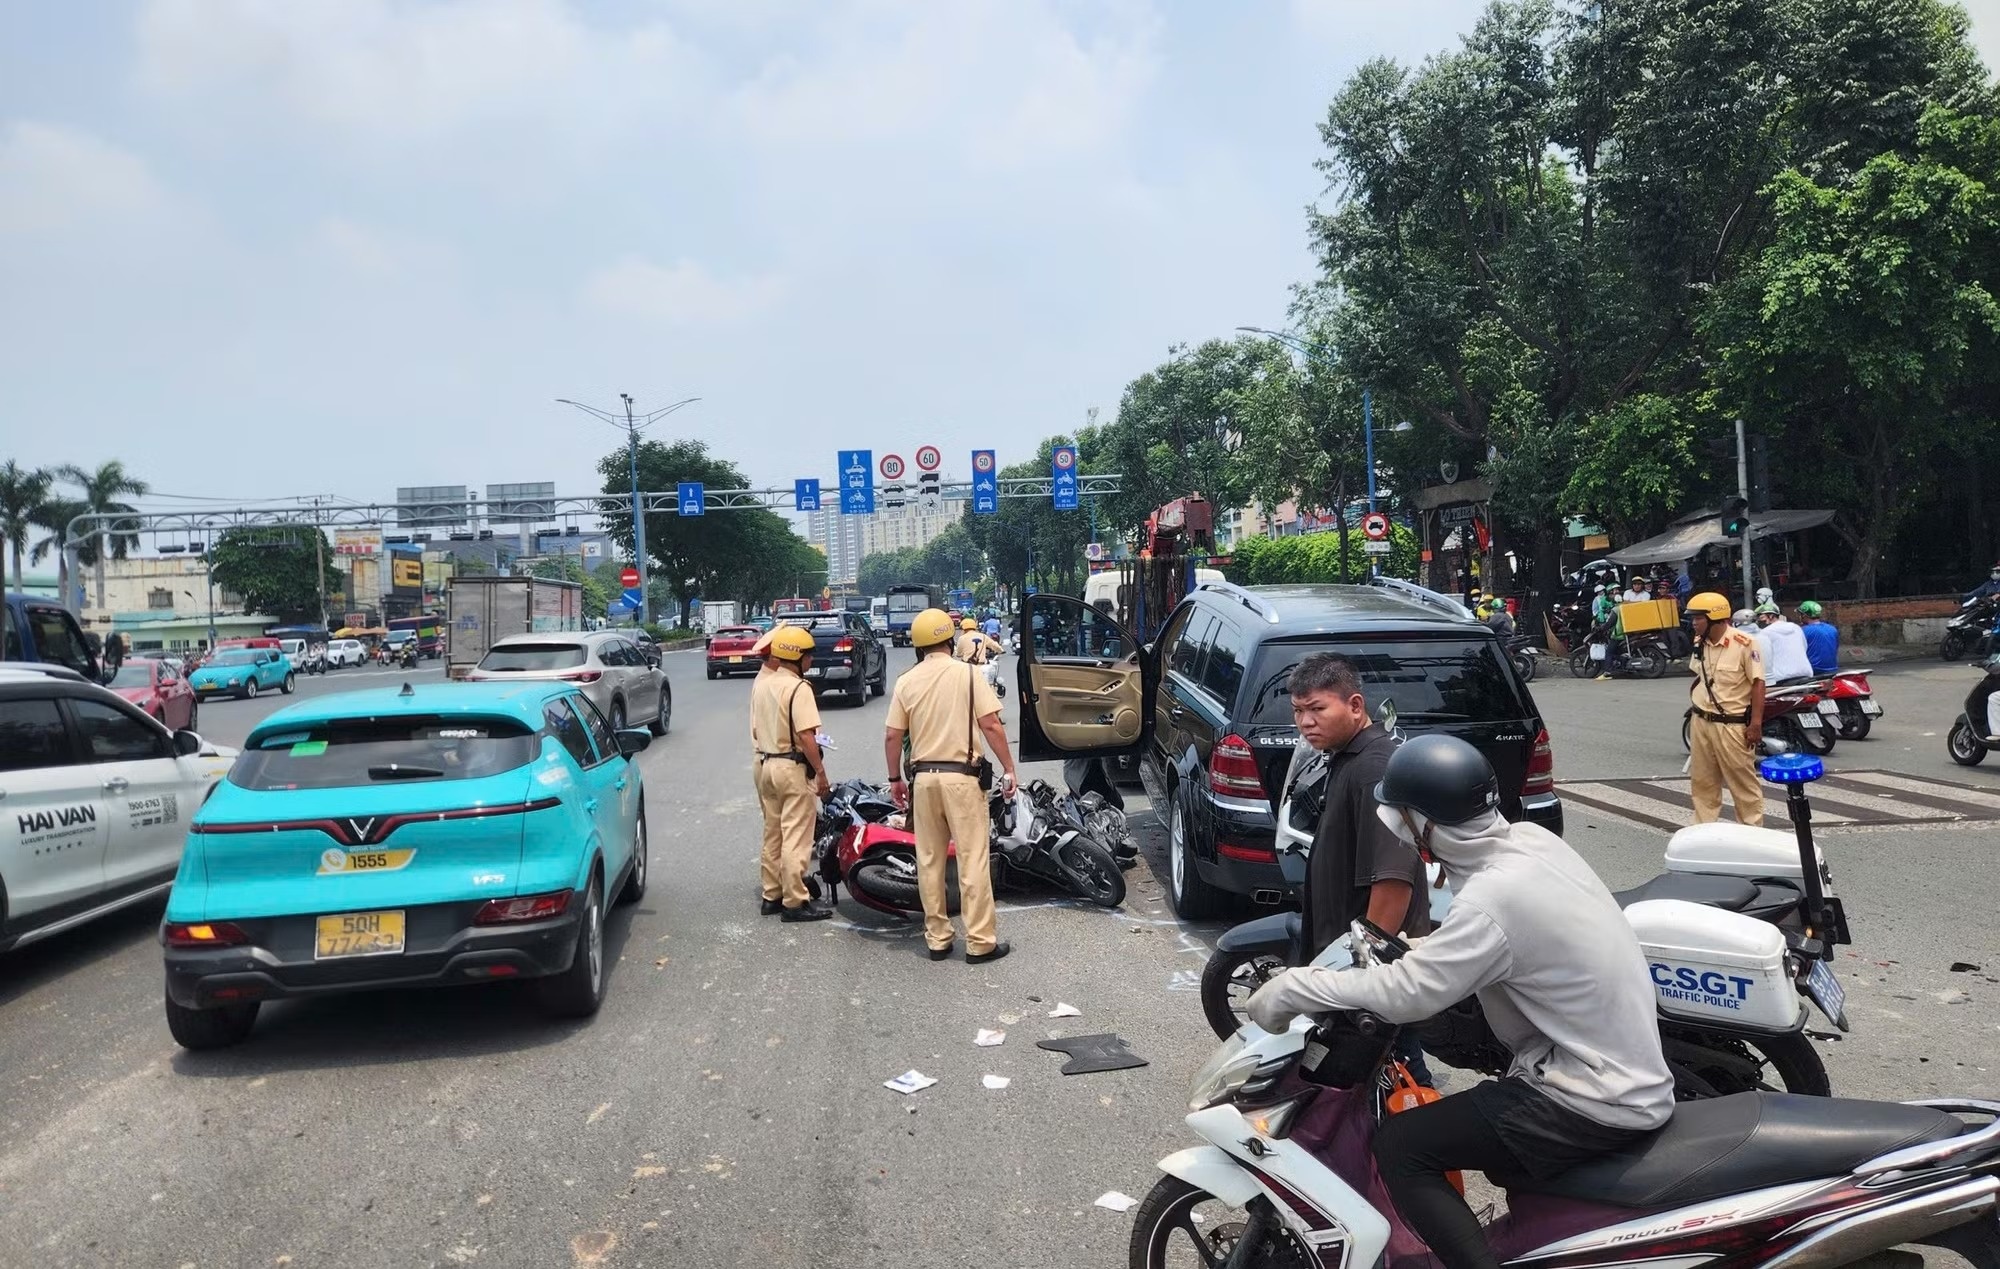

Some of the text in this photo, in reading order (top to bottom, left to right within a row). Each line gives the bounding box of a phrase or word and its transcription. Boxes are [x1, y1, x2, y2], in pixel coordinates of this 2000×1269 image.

[886, 461, 898, 473] 80
[923, 453, 934, 464] 60
[979, 457, 989, 467] 50
[1059, 454, 1069, 464] 50
[17, 804, 96, 834] HAI VAN
[21, 826, 96, 846] LUXURY TRANSPORTATION
[351, 854, 387, 869] 1555
[342, 915, 380, 934] 50H
[1650, 963, 1754, 1000] C.S.G.T
[1660, 987, 1741, 1010] TRAFFIC POLICE
